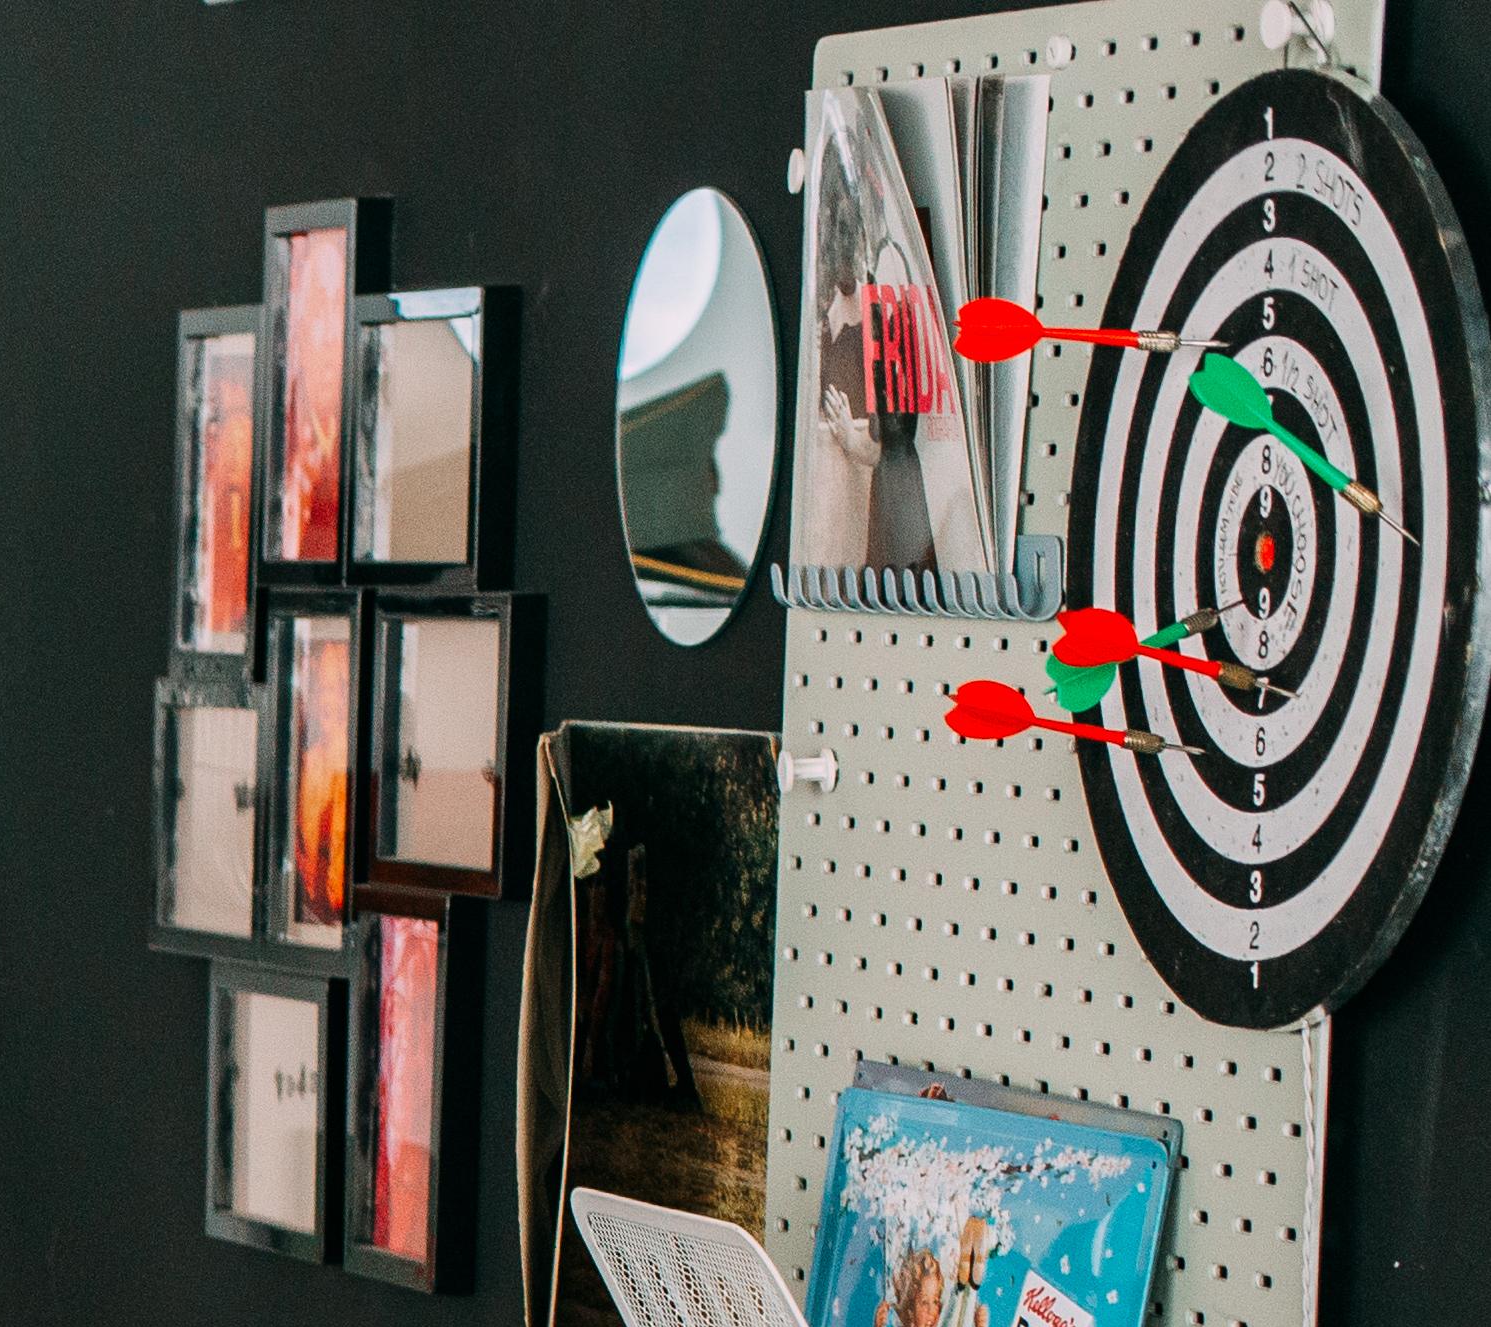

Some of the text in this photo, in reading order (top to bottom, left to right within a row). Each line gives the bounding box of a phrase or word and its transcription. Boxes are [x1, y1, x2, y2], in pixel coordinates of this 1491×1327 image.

[1263, 106, 1274, 140] 1
[1264, 151, 1275, 182] 2
[1314, 160, 1364, 227] SHOTS
[1262, 198, 1276, 233] 3
[1263, 249, 1274, 280] 4
[1301, 259, 1339, 312] SHOT
[1262, 297, 1275, 330] 5
[862, 283, 956, 414] FRIDA
[1262, 347, 1274, 378] 6
[1303, 375, 1338, 443] SHOT
[1262, 445, 1272, 475] 8
[1260, 485, 1273, 519] 9
[1258, 587, 1271, 620] 9
[1258, 630, 1269, 660] 8
[1255, 727, 1266, 757] 6
[1253, 773, 1266, 807] 5
[1252, 824, 1262, 854] 4
[1249, 869, 1262, 904] 3
[1249, 920, 1260, 950] 2
[1250, 960, 1260, 990] 1
